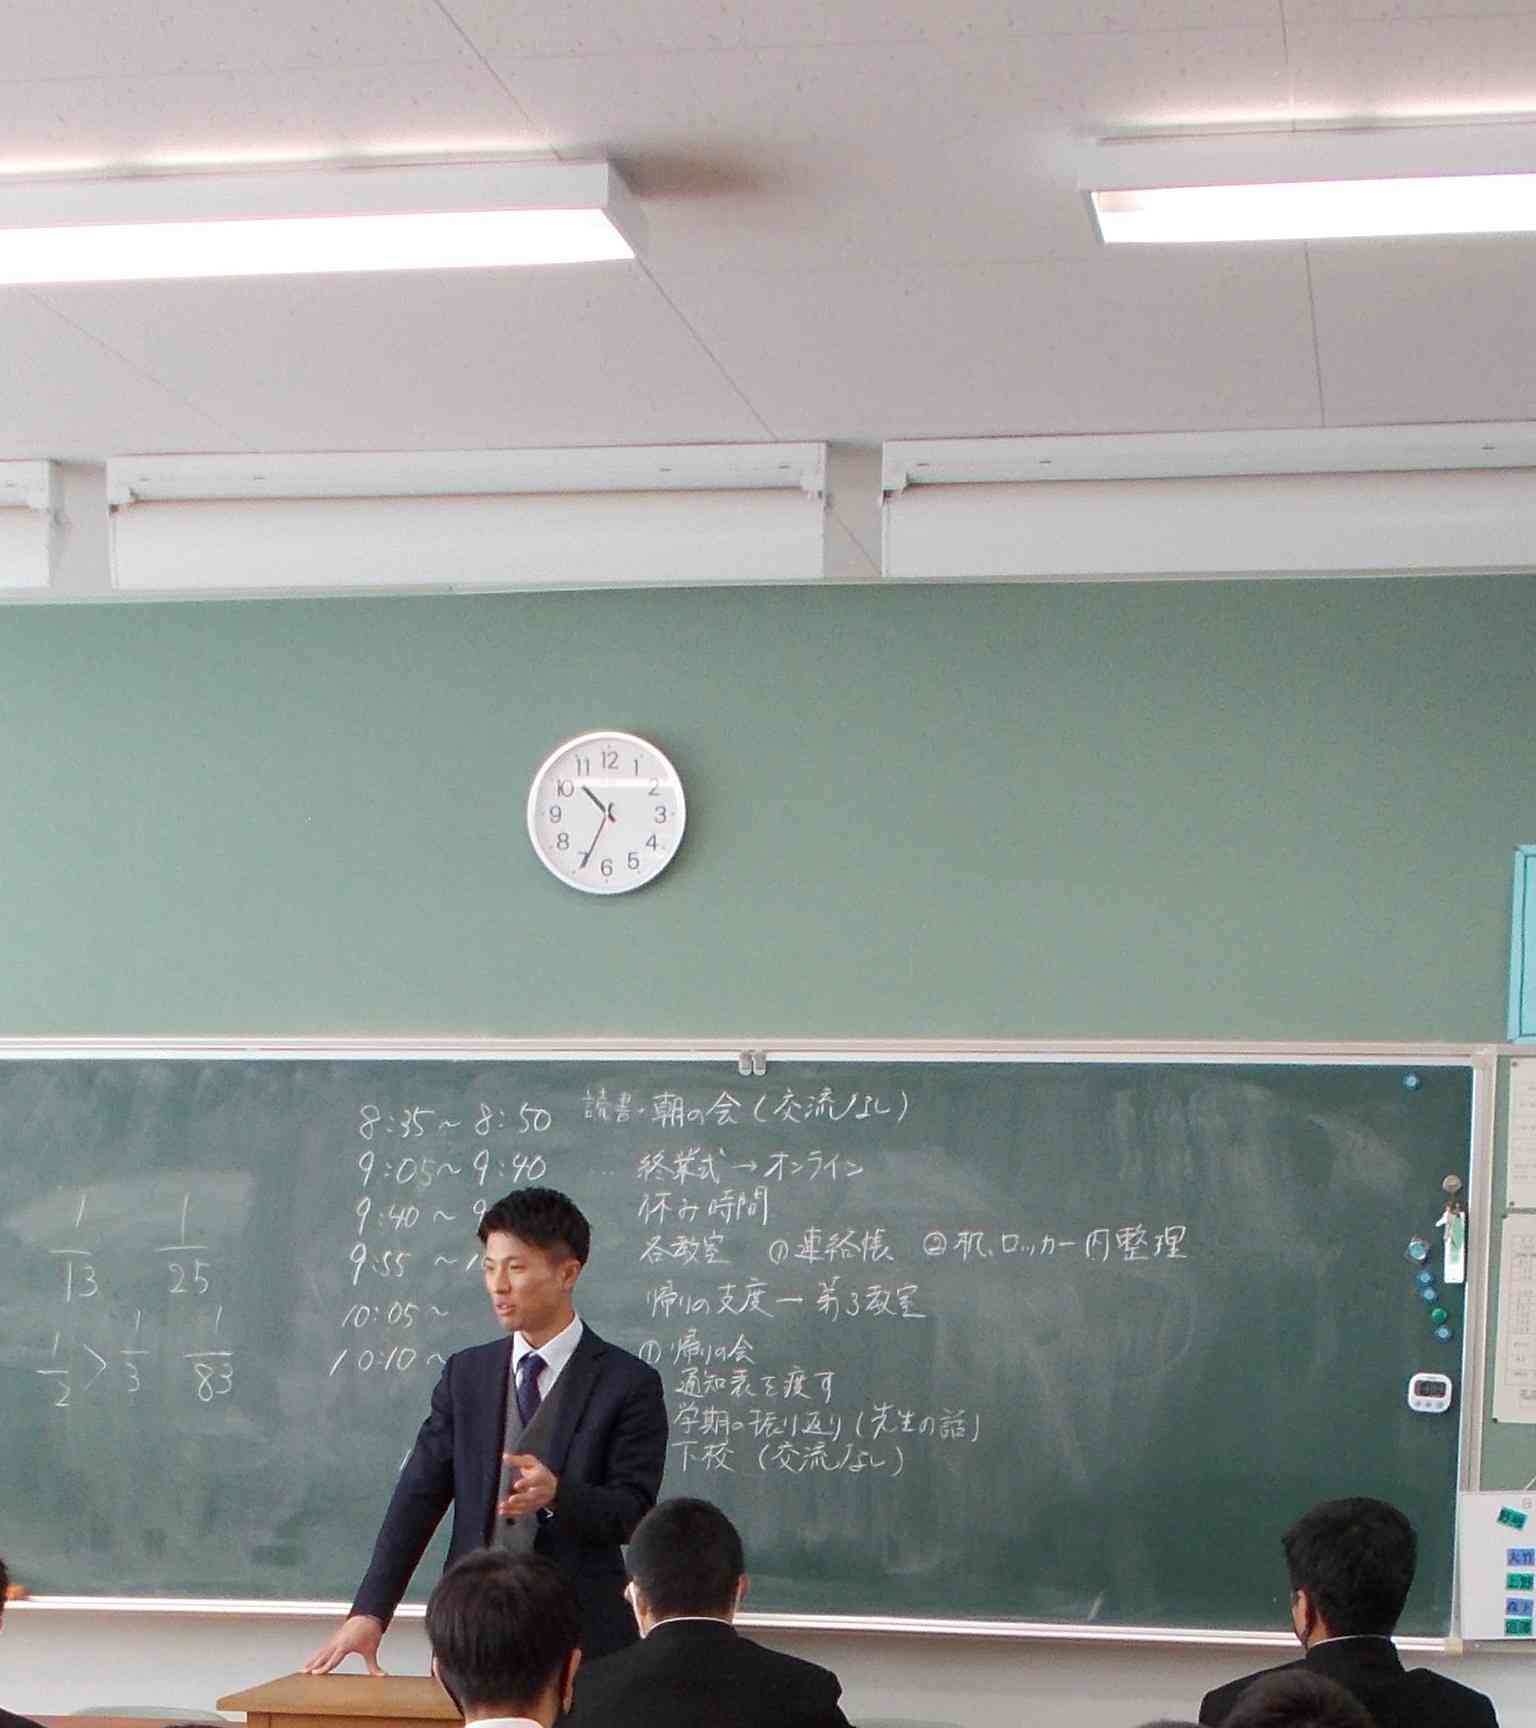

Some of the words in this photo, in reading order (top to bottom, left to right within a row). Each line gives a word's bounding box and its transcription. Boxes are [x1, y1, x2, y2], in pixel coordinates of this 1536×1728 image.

[575, 758, 590, 776] 11
[602, 751, 619, 770] 12
[633, 759, 639, 777] 1
[556, 779, 575, 798] 10
[648, 778, 661, 797] 2
[549, 806, 562, 824] 9
[654, 806, 668, 824] 3
[556, 832, 570, 850] 8
[645, 833, 658, 852] 4
[600, 859, 614, 877] 6
[627, 851, 641, 870] 5
[636, 1185, 770, 1227] 休み時間
[674, 1366, 837, 1404] 通知表を渡す
[671, 1440, 736, 1473] 下校
